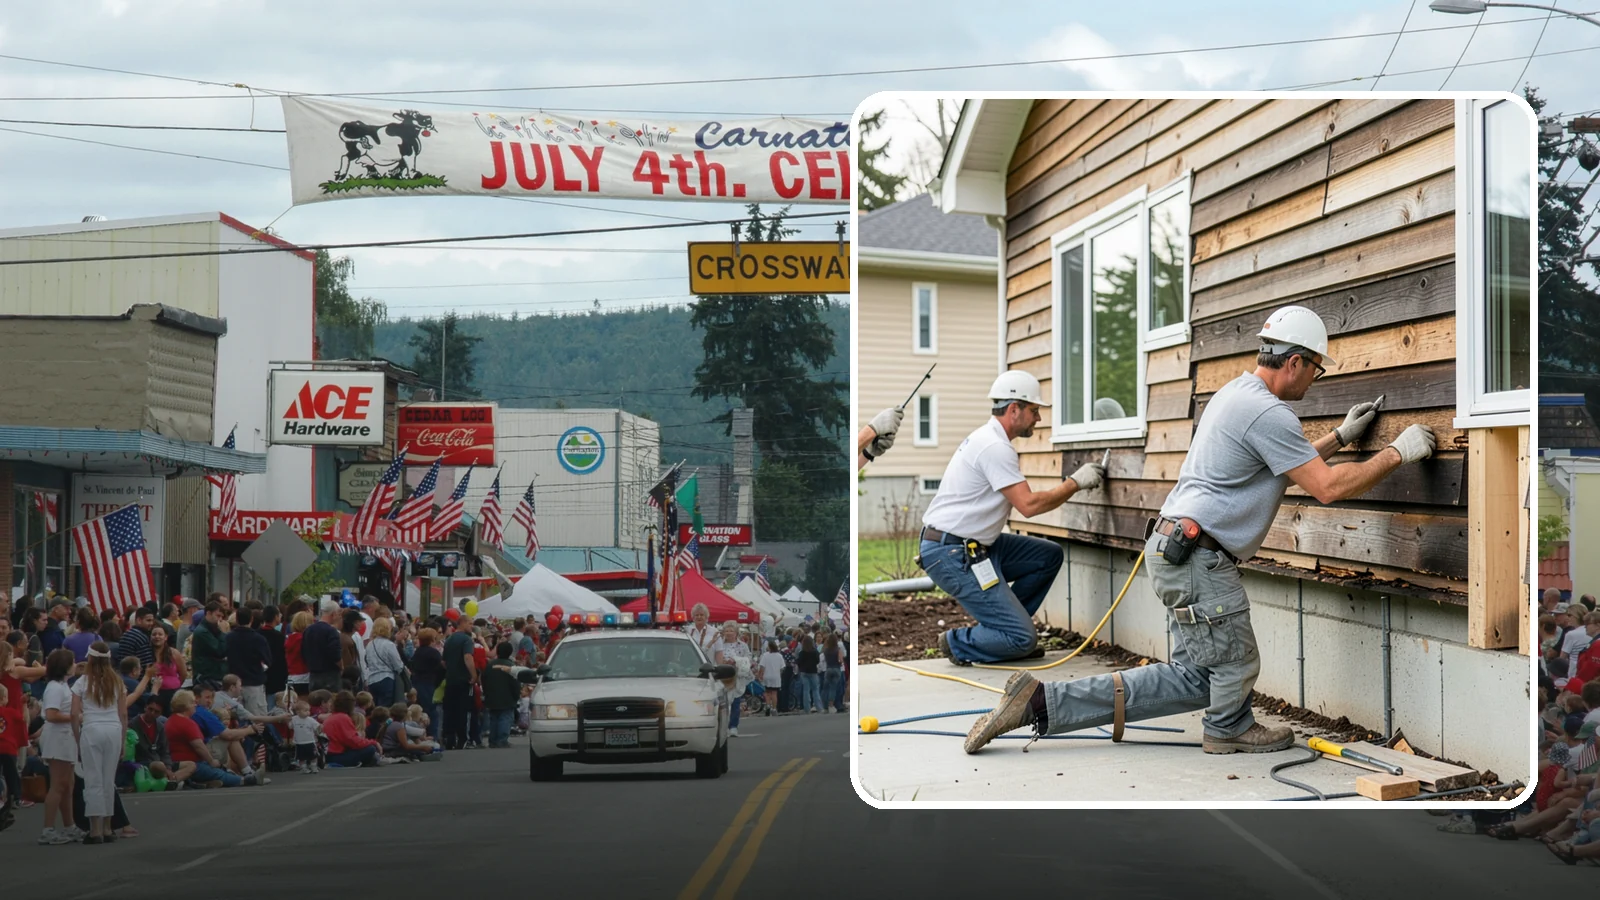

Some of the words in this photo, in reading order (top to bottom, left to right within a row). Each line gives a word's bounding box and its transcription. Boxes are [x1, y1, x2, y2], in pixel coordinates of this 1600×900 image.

[481, 141, 605, 192] JULY
[632, 150, 746, 198] 4th.
[697, 254, 850, 280] CROSSWA
[282, 380, 373, 420] ACE
[405, 409, 452, 422] CEDAR
[283, 421, 371, 436] Hardware
[416, 428, 477, 447] Coca-Cola
[353, 467, 386, 479] Simpl
[96, 485, 124, 495] Vincent
[126, 486, 136, 494] de
[137, 486, 155, 495] Paul
[212, 515, 330, 535] HARDARE
[688, 526, 741, 535] CRNATION
[699, 535, 730, 543] GLASS
